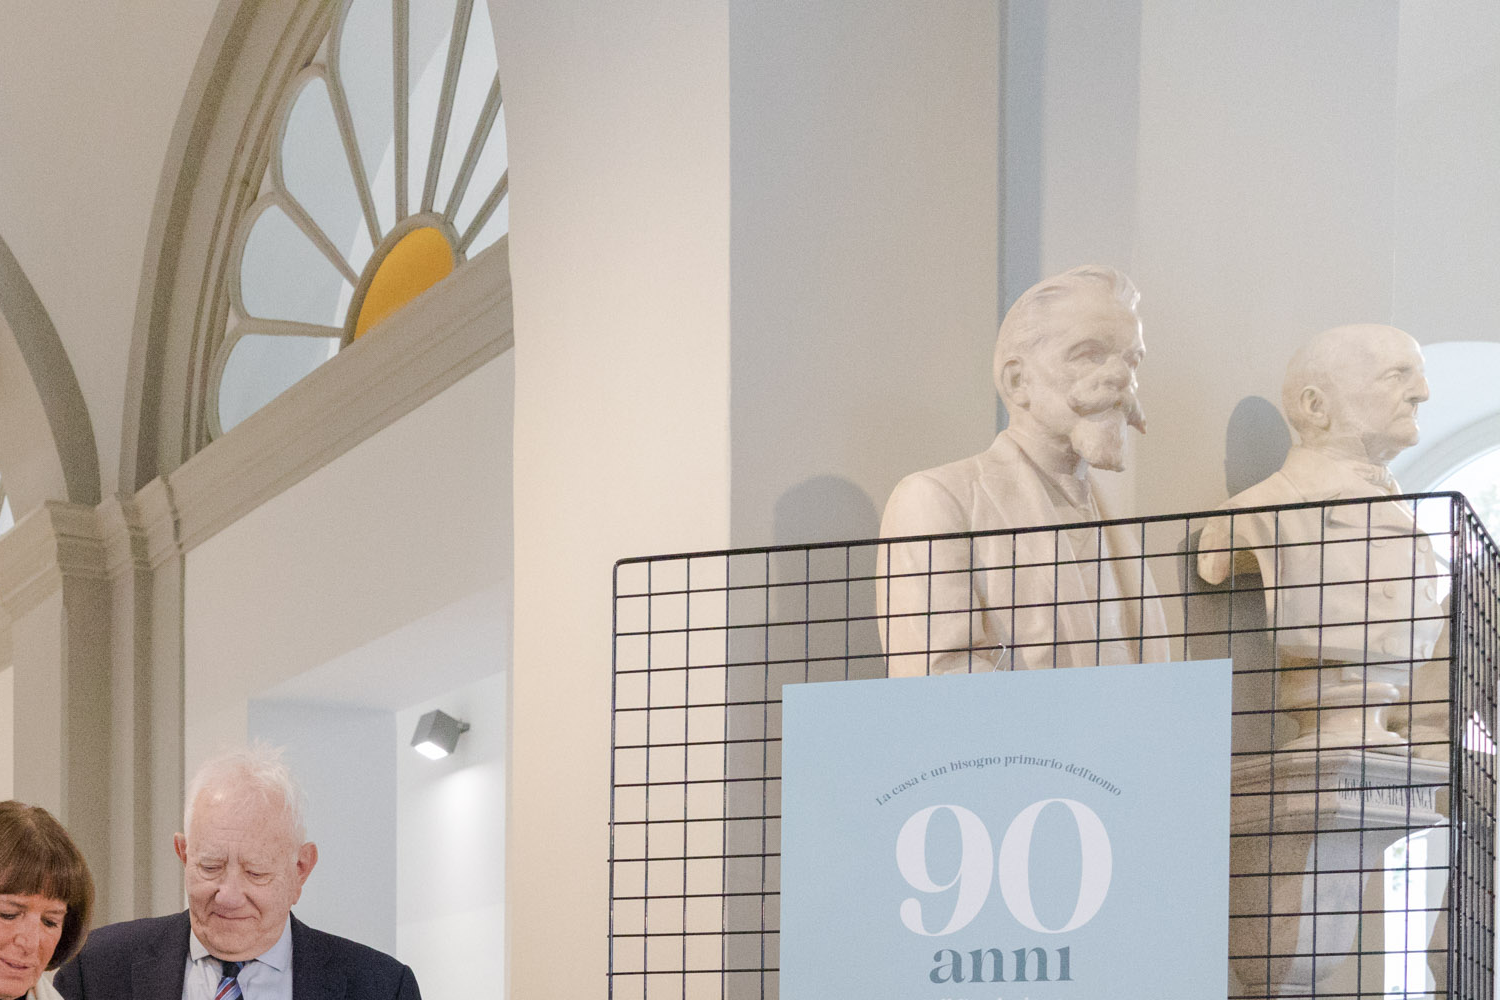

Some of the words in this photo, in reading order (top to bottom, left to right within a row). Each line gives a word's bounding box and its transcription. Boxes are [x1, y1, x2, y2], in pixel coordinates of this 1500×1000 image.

[876, 793, 891, 806] La
[892, 776, 919, 796] casa
[930, 766, 947, 777] un
[950, 755, 1001, 772] bisogno
[1004, 754, 1063, 770] primario
[1064, 763, 1122, 797] dell'uomo
[896, 798, 1112, 936] 90
[929, 945, 1074, 984] anni
